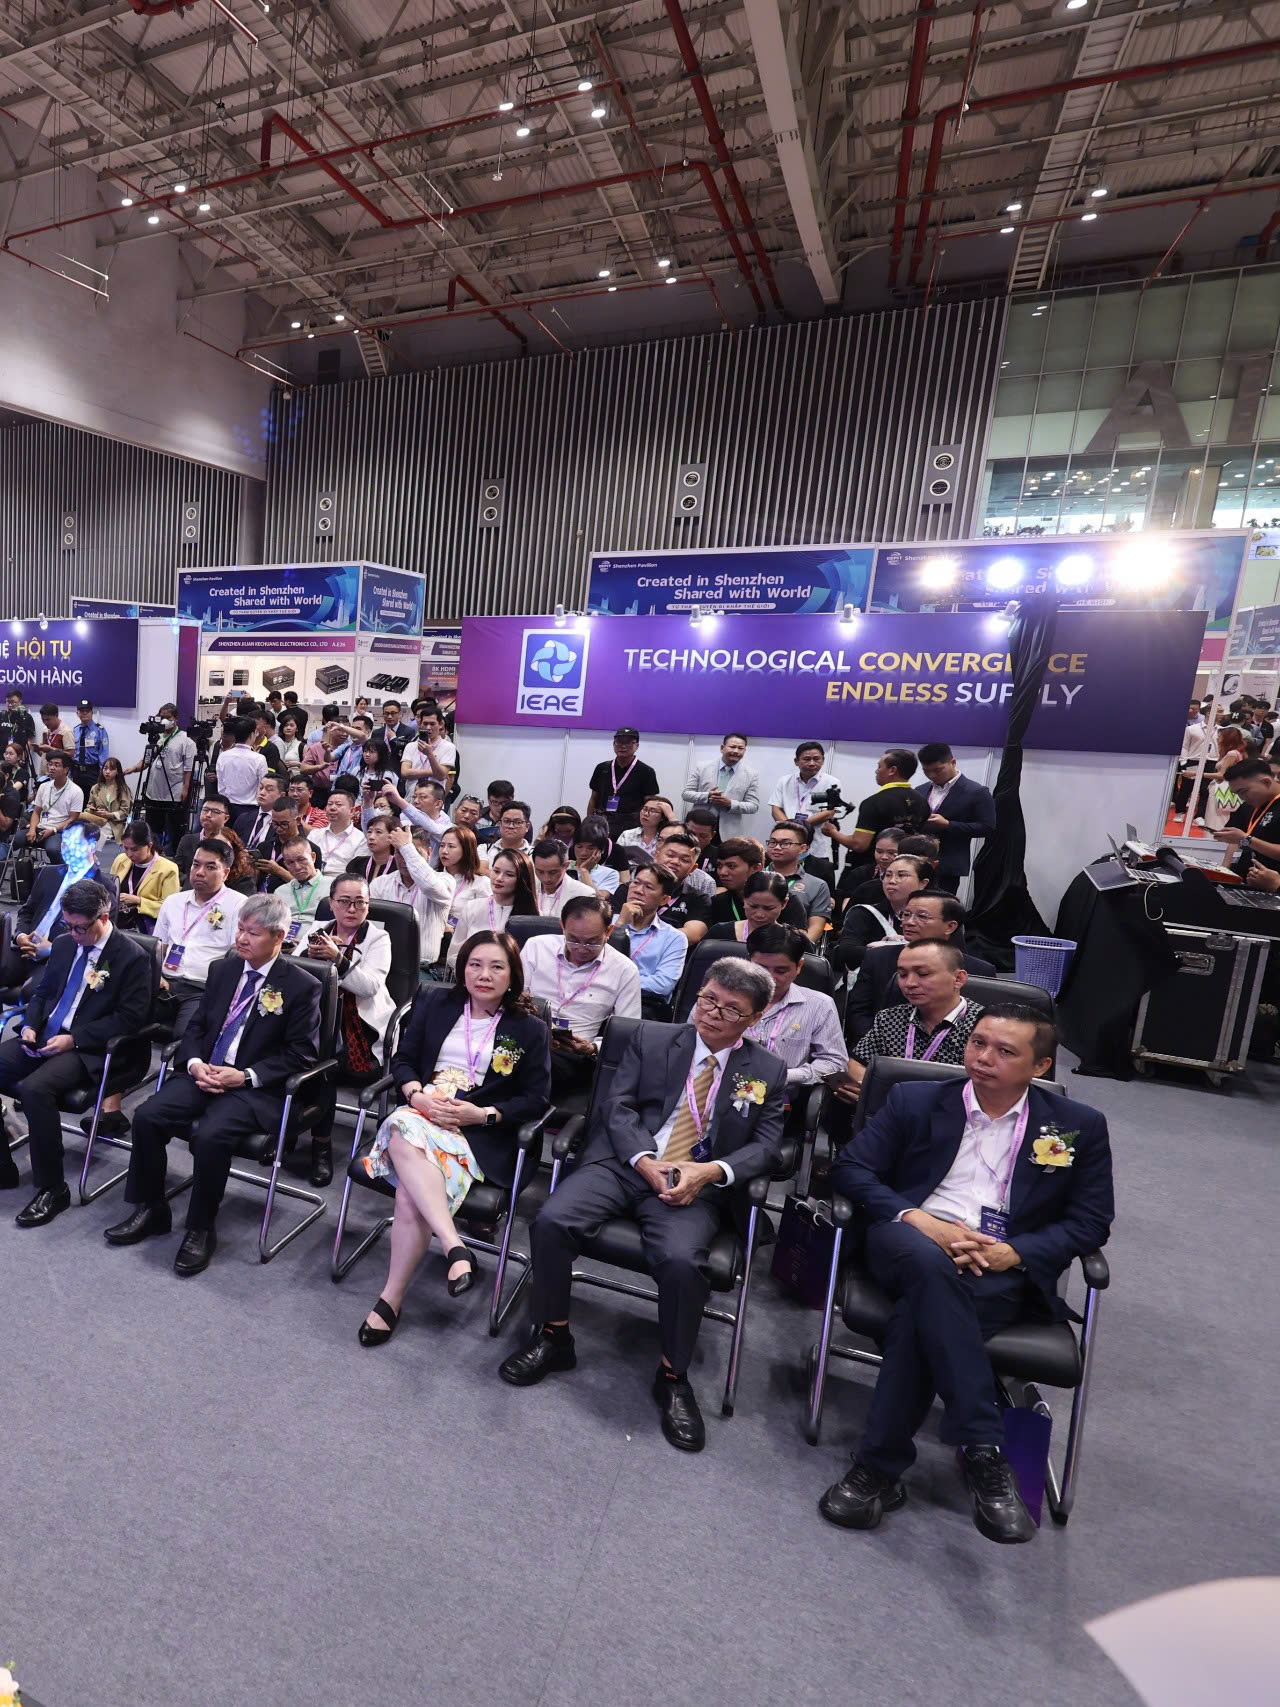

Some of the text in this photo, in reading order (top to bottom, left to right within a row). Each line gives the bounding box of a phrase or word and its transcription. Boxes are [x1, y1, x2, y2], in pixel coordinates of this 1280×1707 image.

[637, 573, 784, 587] Created in Shenzhen
[209, 584, 305, 597] Created in Shenzhen
[373, 586, 408, 600] Created in Shenzhen
[673, 585, 811, 600] Shared with World
[233, 595, 322, 607] Shared with World
[382, 598, 413, 611] Shared with World
[16, 637, 46, 659] HỘI
[50, 639, 72, 659] TỤ
[624, 648, 1089, 673] TECHNOLOGICAL CONVERGCE
[40, 666, 83, 684] HÀNG
[825, 681, 1084, 705] ENDLESS SUPLY
[520, 694, 579, 712] IEAE
